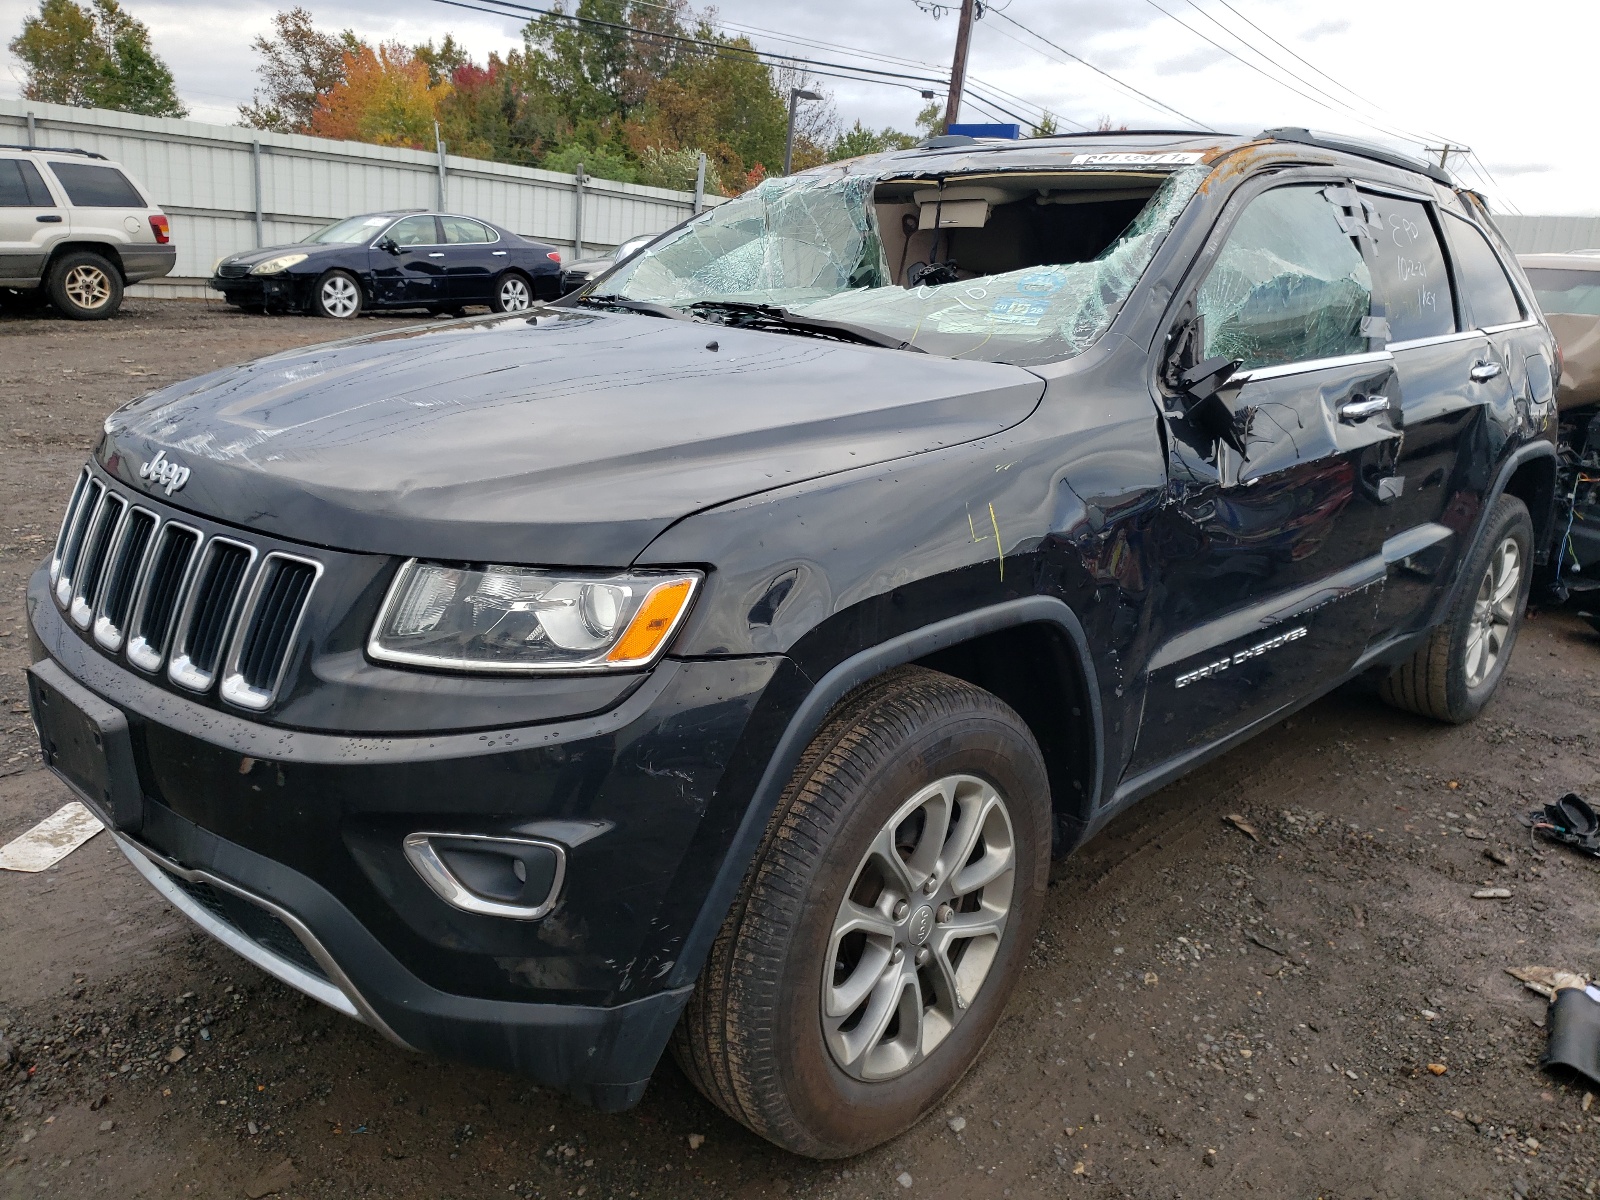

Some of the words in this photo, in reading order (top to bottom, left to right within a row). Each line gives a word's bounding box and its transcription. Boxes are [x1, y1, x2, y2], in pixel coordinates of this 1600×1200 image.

[140, 449, 191, 496] Jeep
[1175, 657, 1231, 689] GRAND
[1233, 626, 1308, 665] CHEROKEE
[917, 910, 929, 940] Jeep
